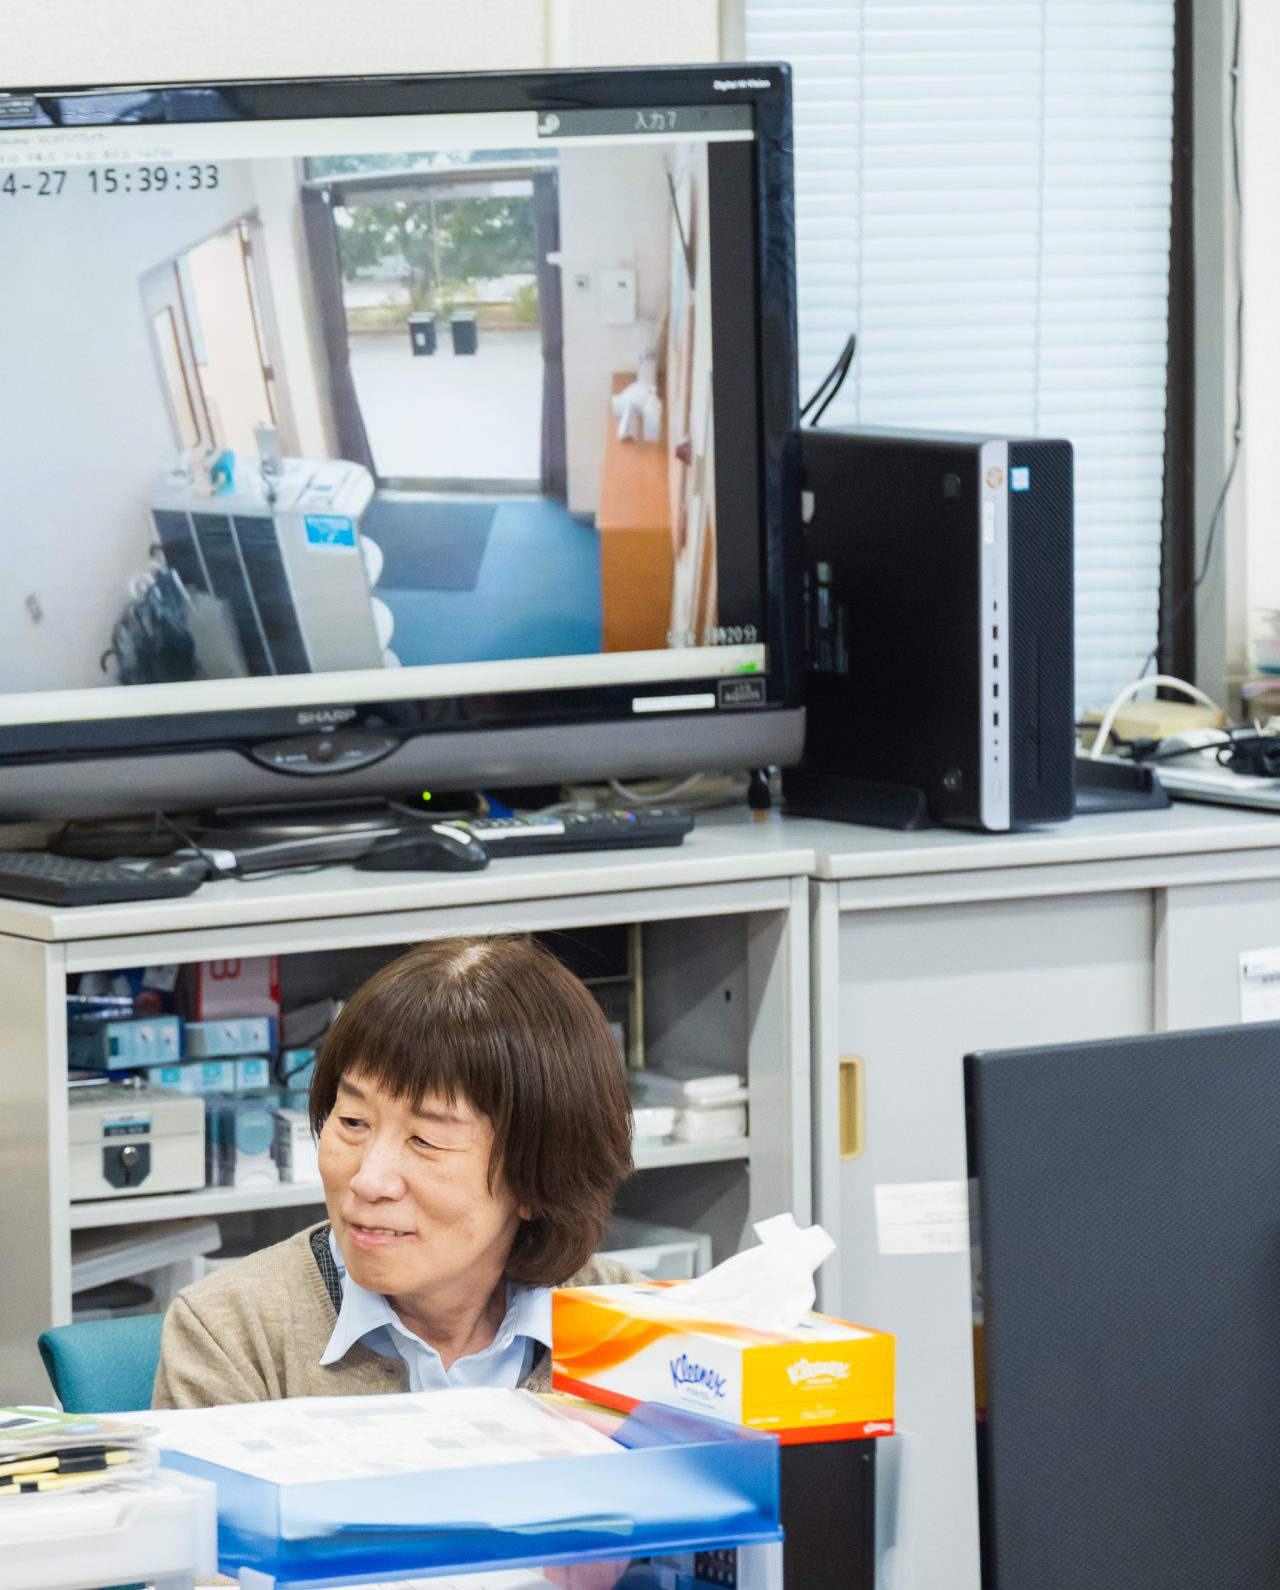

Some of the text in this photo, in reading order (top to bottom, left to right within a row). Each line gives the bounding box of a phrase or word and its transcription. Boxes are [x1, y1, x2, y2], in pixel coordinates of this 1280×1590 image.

[87, 164, 219, 194] 15:39:33
[297, 708, 357, 725] SHARP
[670, 1353, 727, 1398] Kleenex
